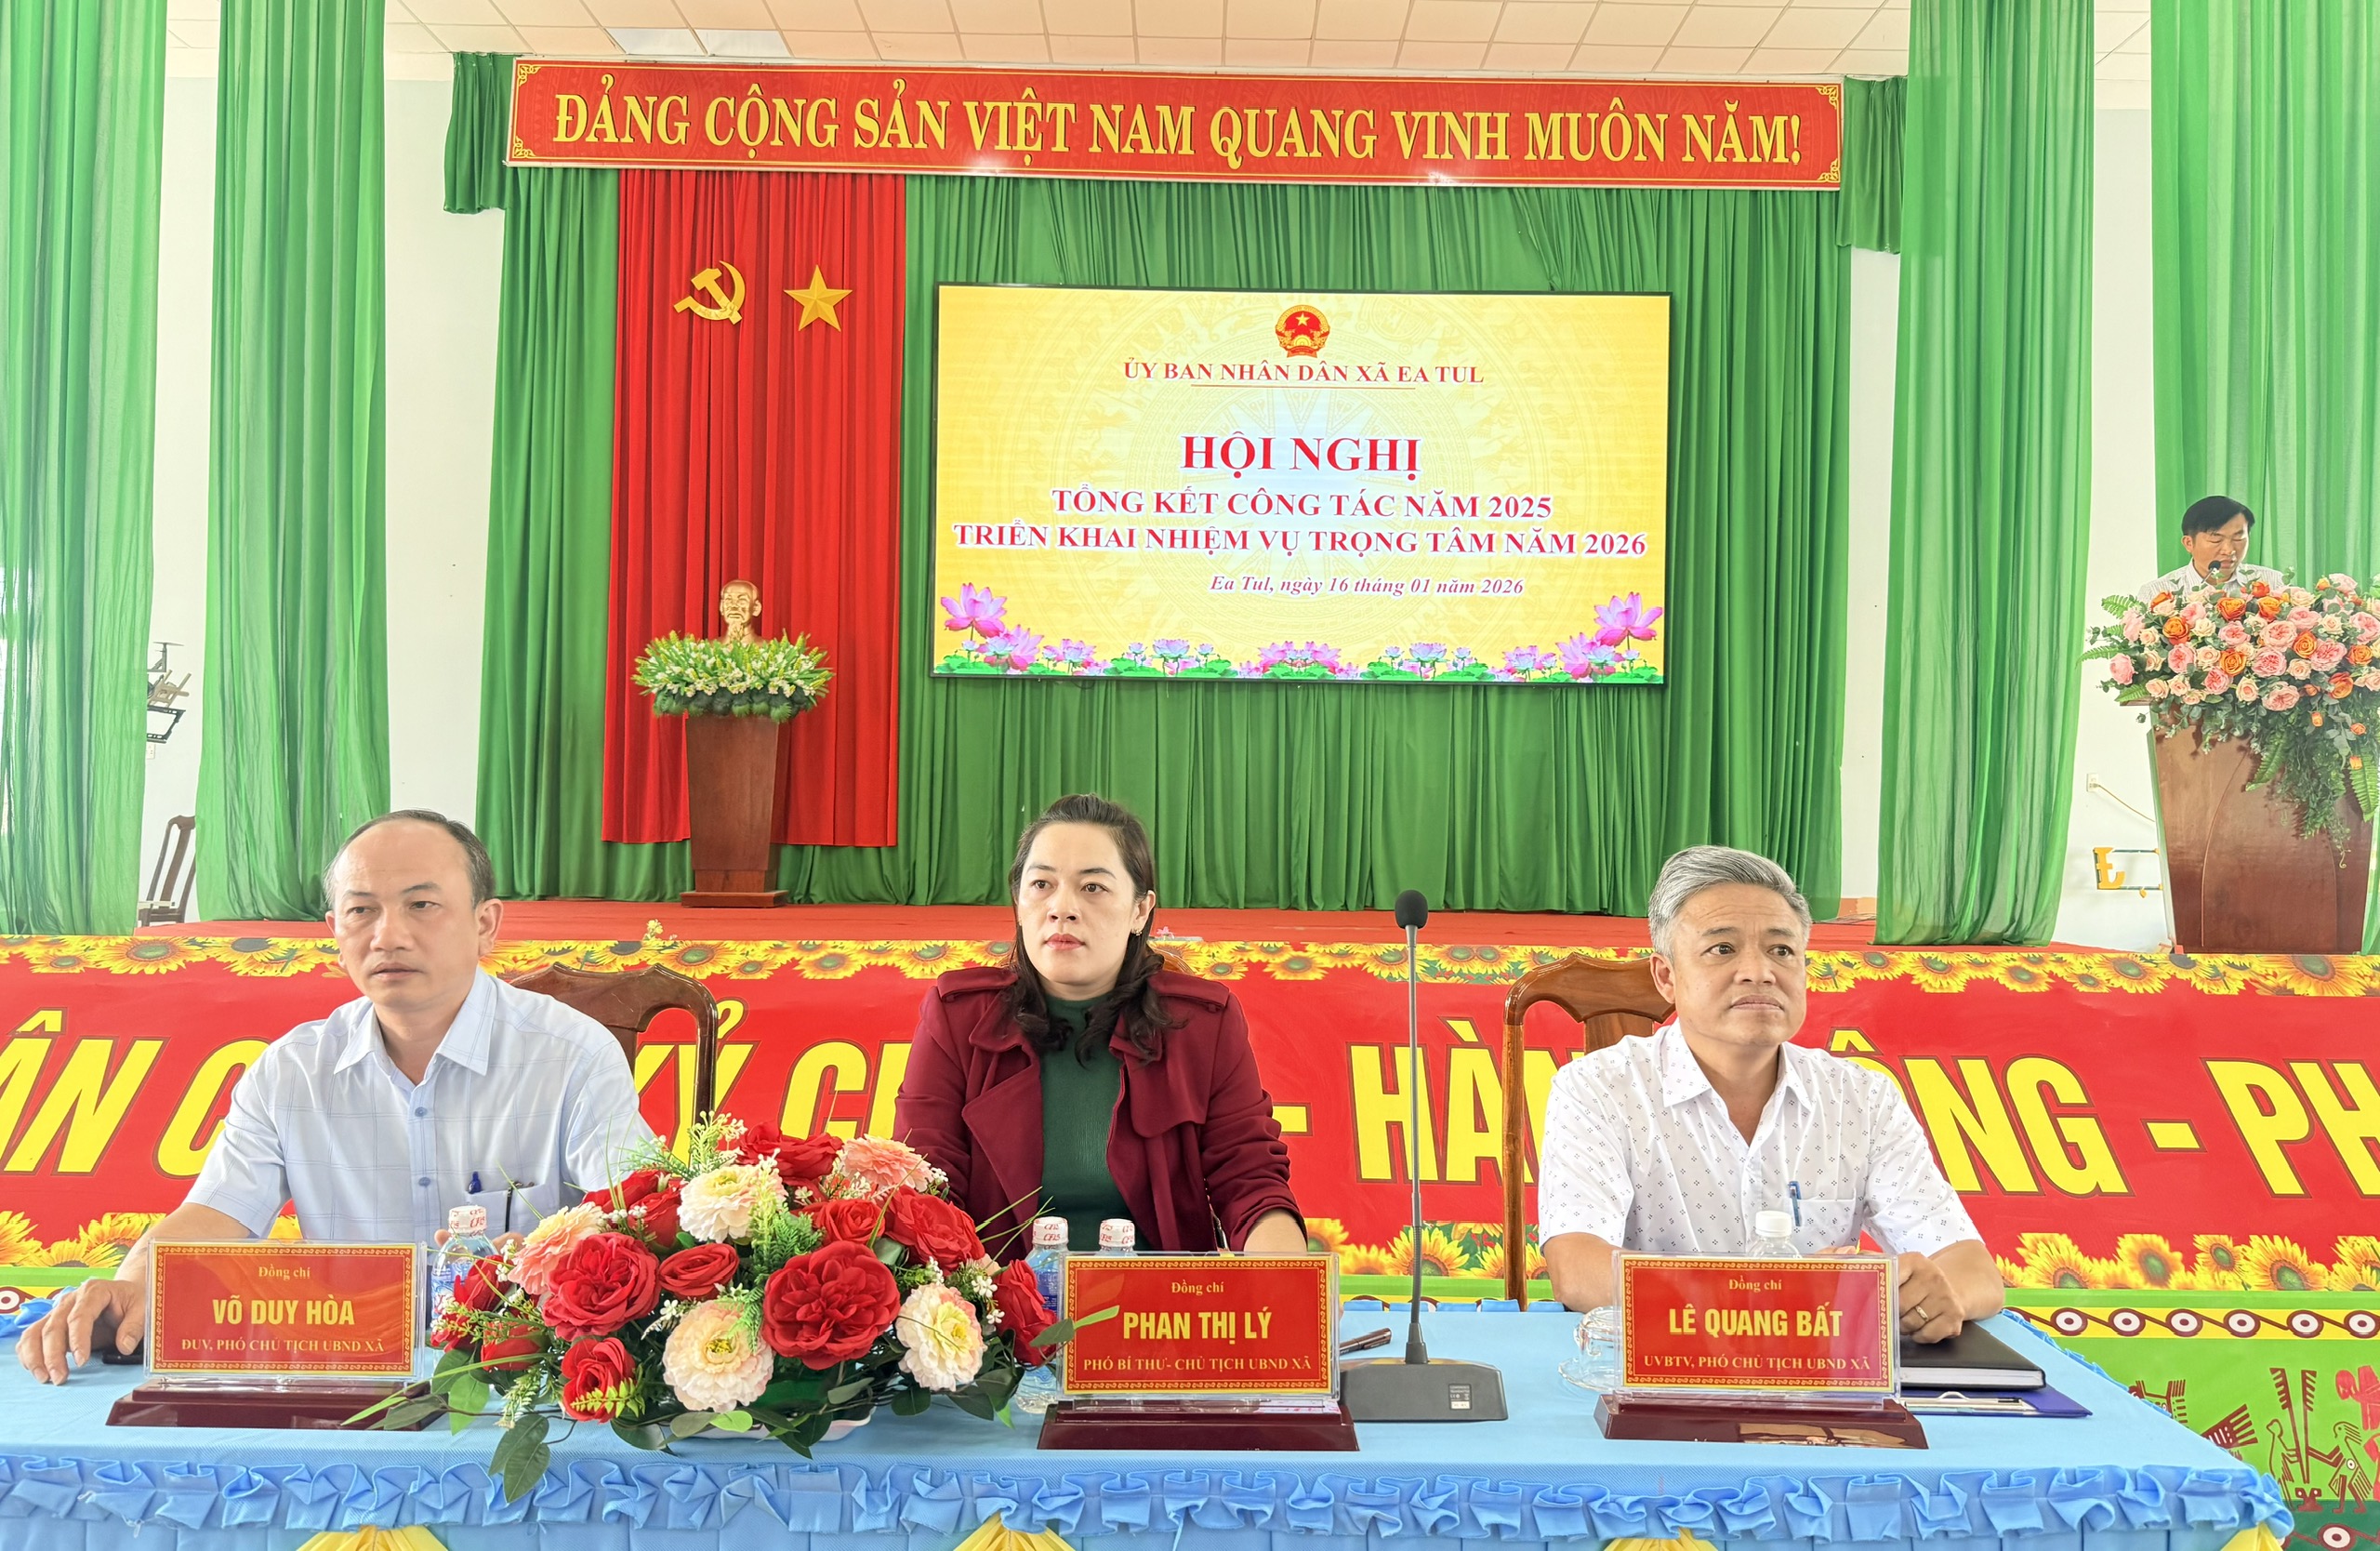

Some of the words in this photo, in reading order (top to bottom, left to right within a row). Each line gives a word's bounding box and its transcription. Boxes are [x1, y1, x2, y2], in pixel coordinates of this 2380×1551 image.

[553, 73, 687, 144] ĐẢNG
[705, 84, 839, 159] CỘNG
[853, 78, 946, 150] SẢN
[963, 87, 1077, 166] VIỆT
[1089, 104, 1196, 154] NAM
[1209, 107, 1378, 170] QUANG
[1391, 110, 1510, 161] VINH
[1524, 98, 1668, 163] MUÔN
[1681, 99, 1802, 165] NĂM!
[1124, 357, 1157, 378] ỦY
[1165, 364, 1212, 379] BAN
[1221, 360, 1290, 380] NHÂN
[1299, 361, 1347, 382] DÂN
[1355, 362, 1390, 382] XÃ
[1397, 365, 1428, 383] EA
[1435, 366, 1484, 383] TUL
[1182, 431, 1274, 479] HỘI
[1290, 436, 1421, 481] NGHỊ
[1154, 486, 1218, 513] KẾT
[1228, 487, 1321, 515] CÔNG
[1330, 489, 1395, 517] TÁC
[1404, 491, 1477, 517] NĂM
[1488, 497, 1551, 518] 2025
[1058, 527, 1137, 548] KHAI
[1145, 526, 1250, 555] NHIỆM
[1259, 531, 1300, 556] VỤ
[1309, 532, 1417, 557] TRỌNG
[1426, 527, 1494, 553] TÂM
[1505, 528, 1576, 554] NĂM
[1585, 535, 1646, 554] 2026
[1210, 577, 1235, 590] Ea
[1242, 577, 1274, 592] Tul,
[1280, 577, 1322, 595] ngày
[1329, 577, 1348, 591] 16
[1354, 578, 1405, 596] tháng
[1411, 579, 1430, 592] 01
[1436, 580, 1474, 593] năm
[1481, 579, 1523, 593] 2026
[2145, 1121, 2202, 1149] -
[258, 1265, 290, 1280] Đồng
[293, 1266, 311, 1278] chí
[1728, 1276, 1761, 1292] Đồng
[1764, 1279, 1782, 1290] chí
[1171, 1279, 1203, 1295] Đồng
[1206, 1282, 1224, 1292] chí
[212, 1294, 243, 1325] VÕ
[251, 1300, 298, 1325] DUY
[307, 1294, 354, 1325] HÒA
[1669, 1304, 1696, 1334] LÊ
[1705, 1309, 1788, 1338] QUANG
[1796, 1302, 1843, 1337] BẤT
[1123, 1312, 1190, 1339] PHAN
[1198, 1312, 1236, 1345] THỊ
[1244, 1306, 1272, 1339] LÝ
[181, 1339, 213, 1351] ĐUV,
[217, 1337, 245, 1350] PHÓ
[249, 1338, 279, 1351] CHỦ
[284, 1340, 318, 1354] TỊCH
[323, 1340, 361, 1352] UBND
[364, 1339, 384, 1352] XÃ
[1083, 1356, 1114, 1370] PHÓ
[1117, 1358, 1131, 1370] BÍ
[1136, 1358, 1171, 1370] THƯ-
[1175, 1356, 1206, 1370] CHỦ
[1210, 1359, 1245, 1372] TỊCH
[1249, 1359, 1288, 1370] UBND
[1291, 1356, 1312, 1370] XÃ
[1644, 1356, 1695, 1369] UVBTV,
[1699, 1354, 1728, 1369] PHÓ
[1732, 1355, 1764, 1369] CHỦ
[1766, 1358, 1803, 1371] TỊCH
[1806, 1358, 1846, 1370] UBND
[1850, 1356, 1871, 1370] XÃ
